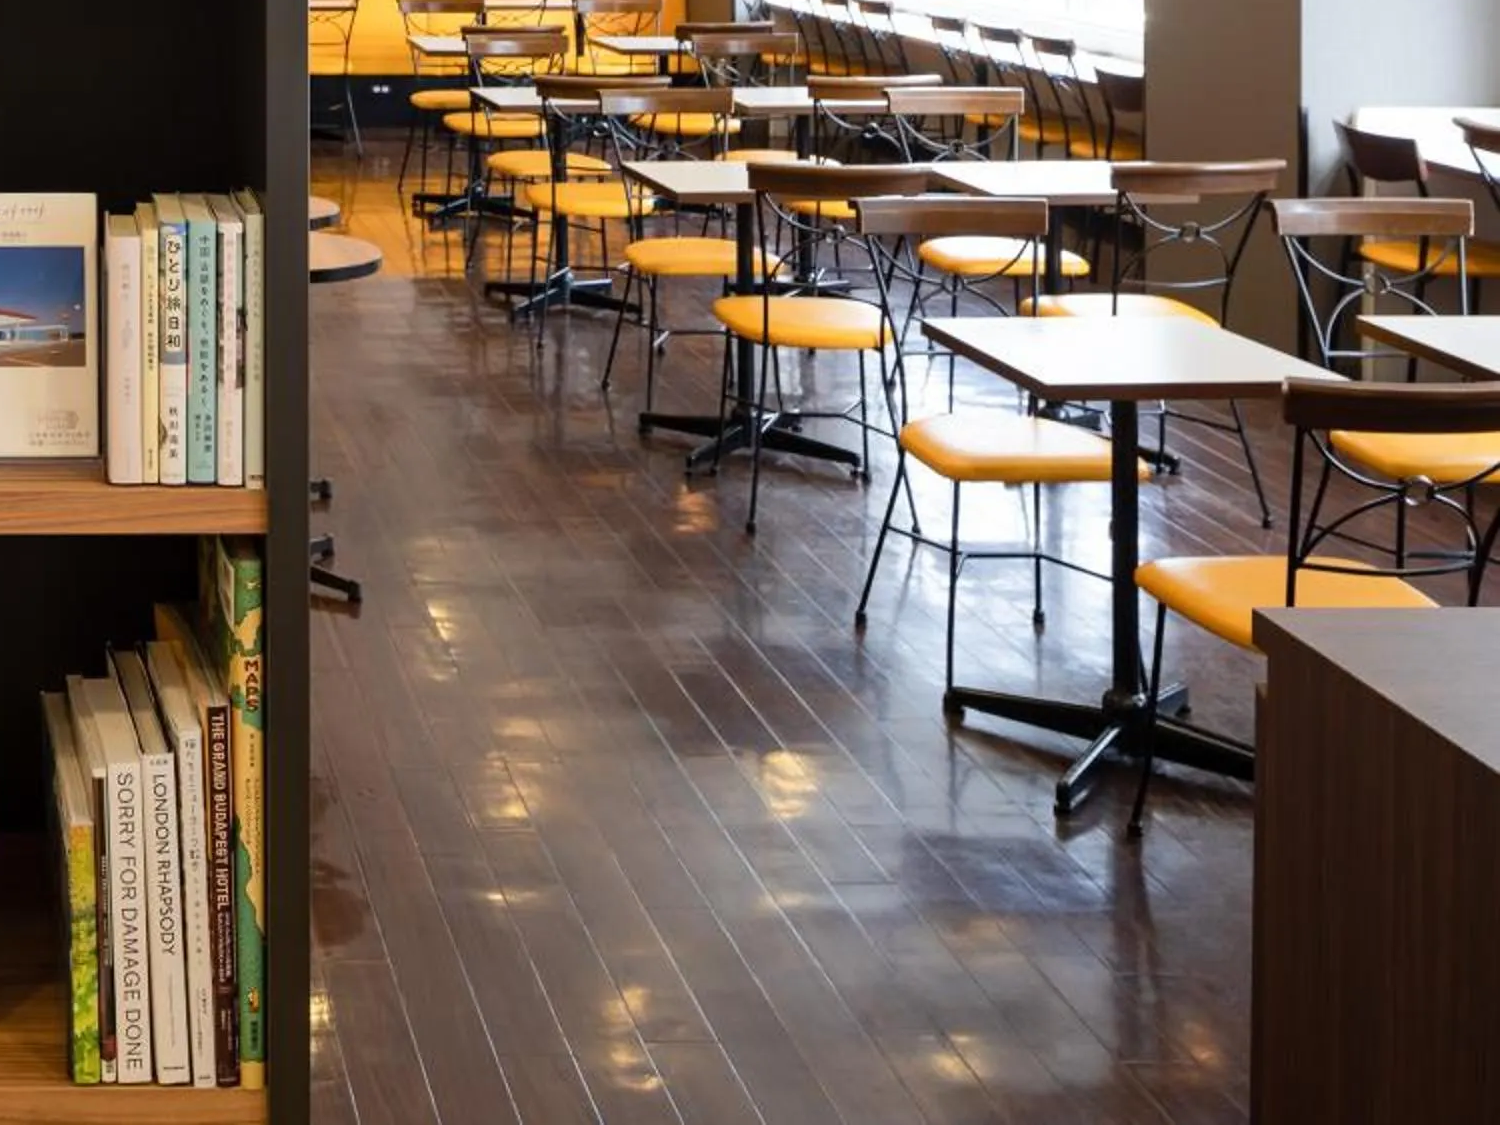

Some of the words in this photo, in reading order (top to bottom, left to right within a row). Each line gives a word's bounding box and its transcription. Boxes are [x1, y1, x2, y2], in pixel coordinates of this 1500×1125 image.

[167, 240, 181, 349] ひとり旅日和
[243, 659, 260, 712] MAPS
[212, 713, 226, 740] THE
[213, 742, 228, 791] GRAND
[117, 772, 136, 847] SORRY
[152, 773, 170, 855] LONDON
[214, 793, 229, 866] BUDAPEST
[120, 856, 137, 901] FOR
[157, 860, 175, 956] RHAPSODY
[216, 868, 230, 911] HOTEL
[121, 908, 141, 1001] DAMAGE
[125, 1009, 143, 1070] DONE
